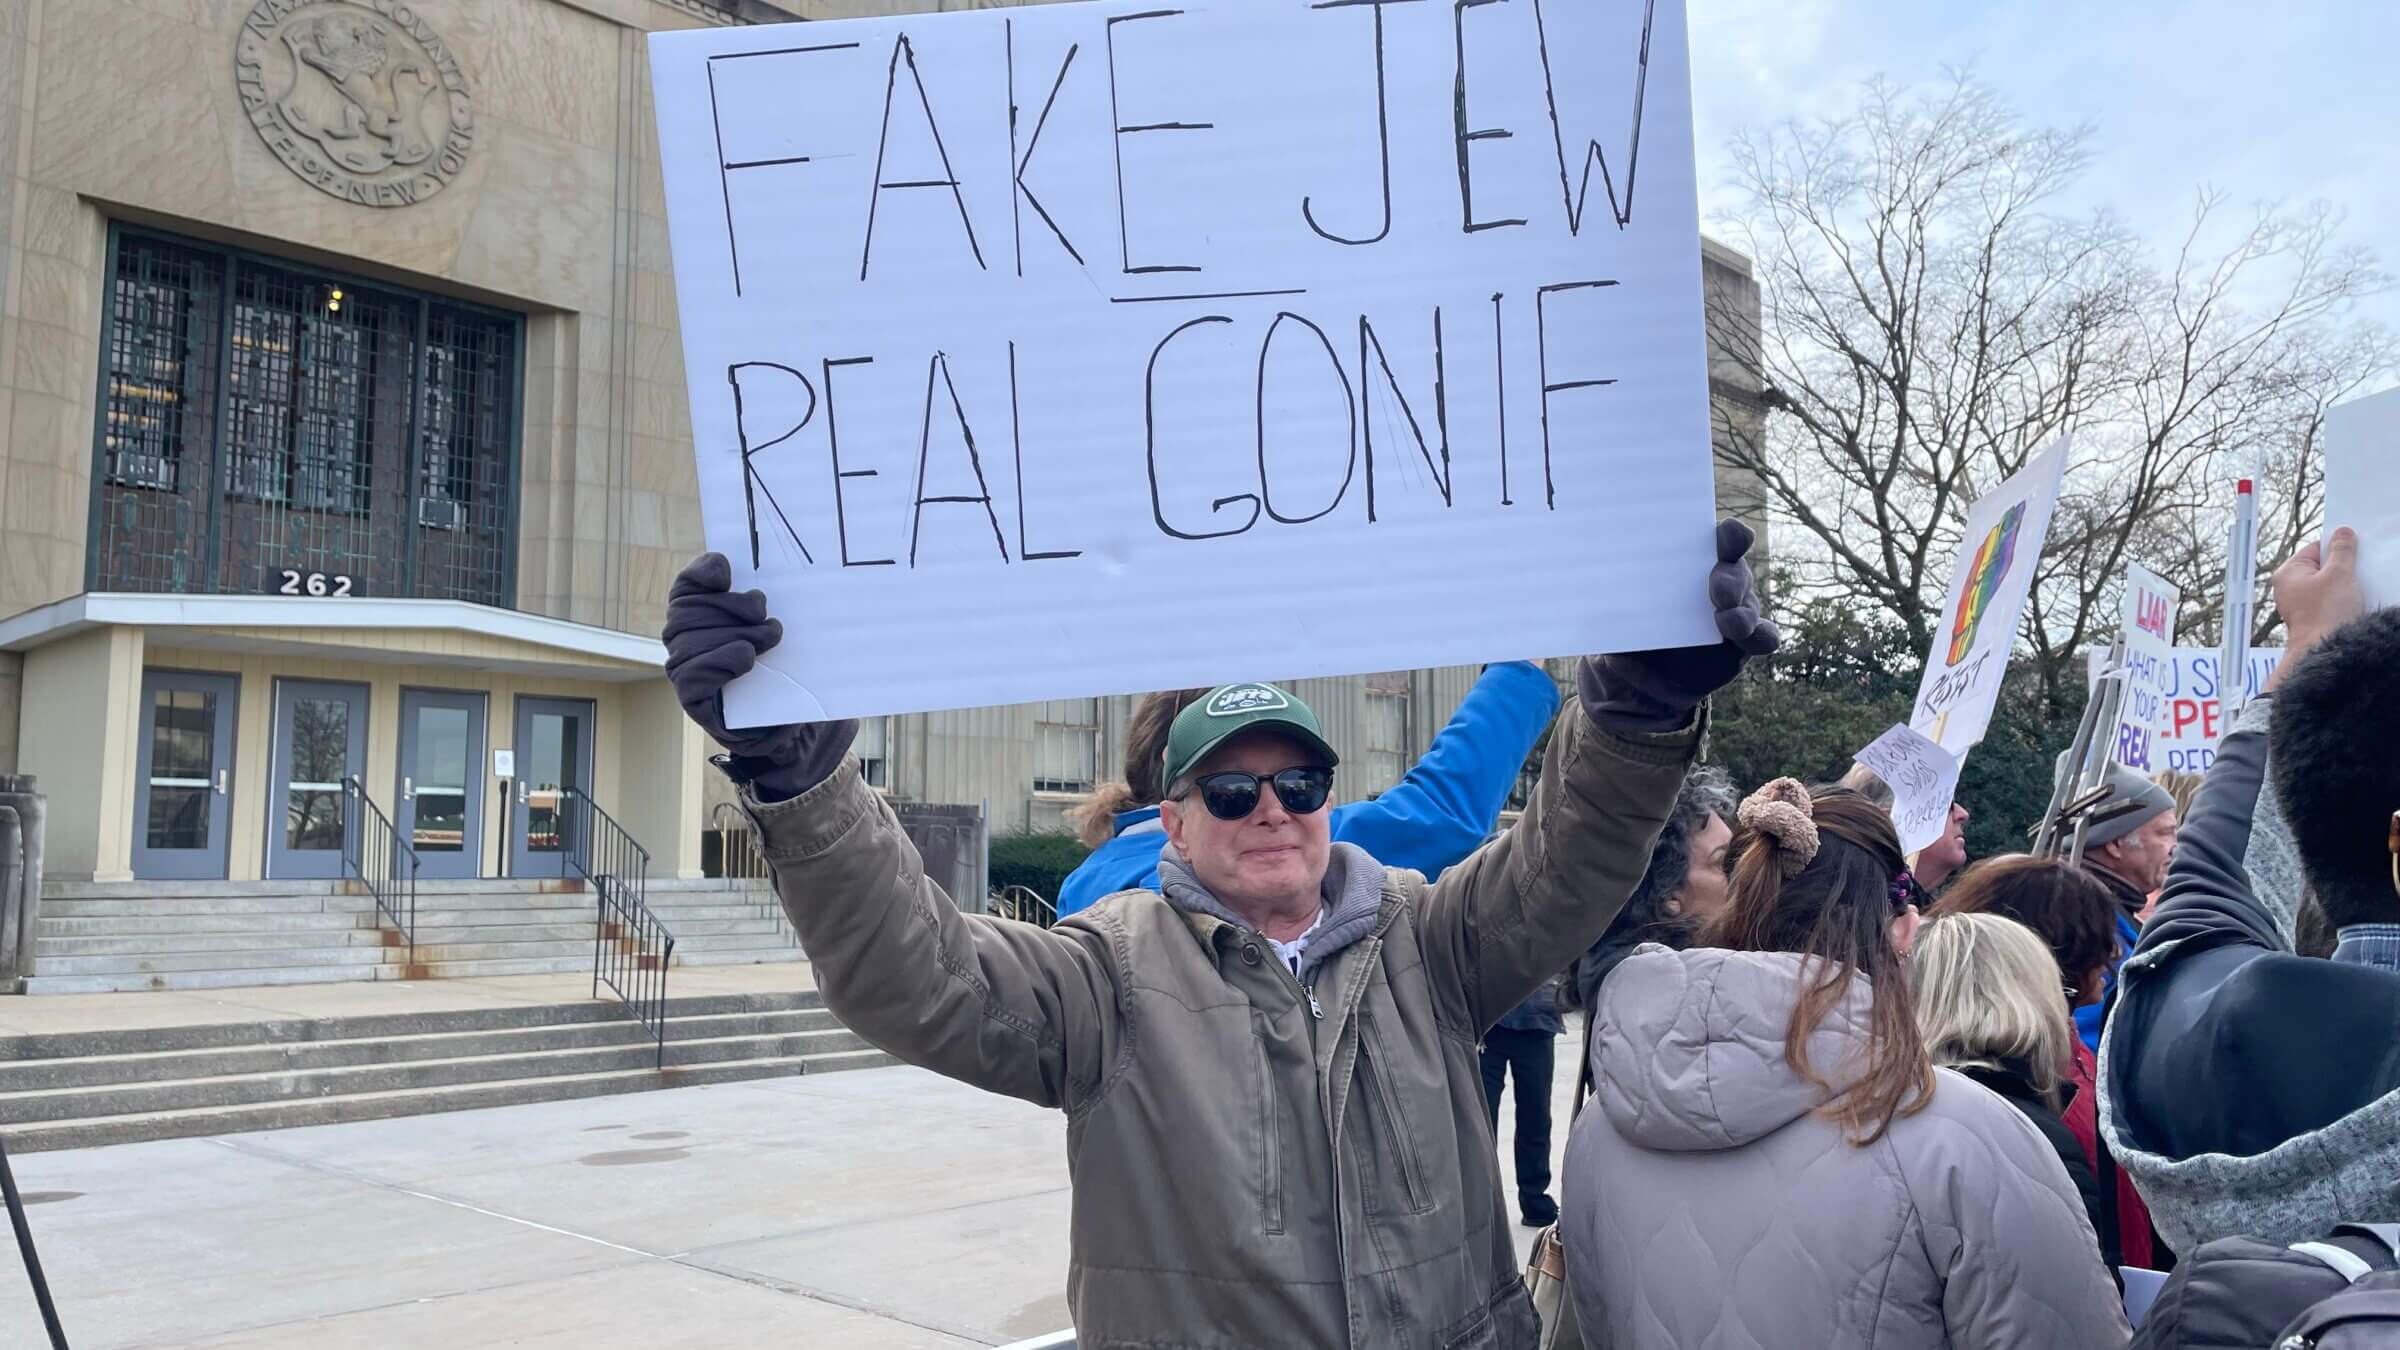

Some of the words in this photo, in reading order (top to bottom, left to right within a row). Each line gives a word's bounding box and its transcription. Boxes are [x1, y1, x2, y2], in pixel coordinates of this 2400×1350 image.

[236, 51, 295, 153] STATE
[302, 158, 335, 185] OF
[345, 178, 417, 205] NEW
[423, 118, 474, 188] YORK
[707, 9, 1215, 297] FAKE
[1303, 0, 1655, 247] JEW
[727, 340, 1083, 571] REAL
[1146, 279, 1621, 540] GONIF
[280, 569, 352, 597] 262
[2135, 586, 2168, 642] LIAR
[2126, 647, 2157, 684] WHAT
[1219, 688, 1273, 707] JETS
[2133, 686, 2159, 726] YOUR
